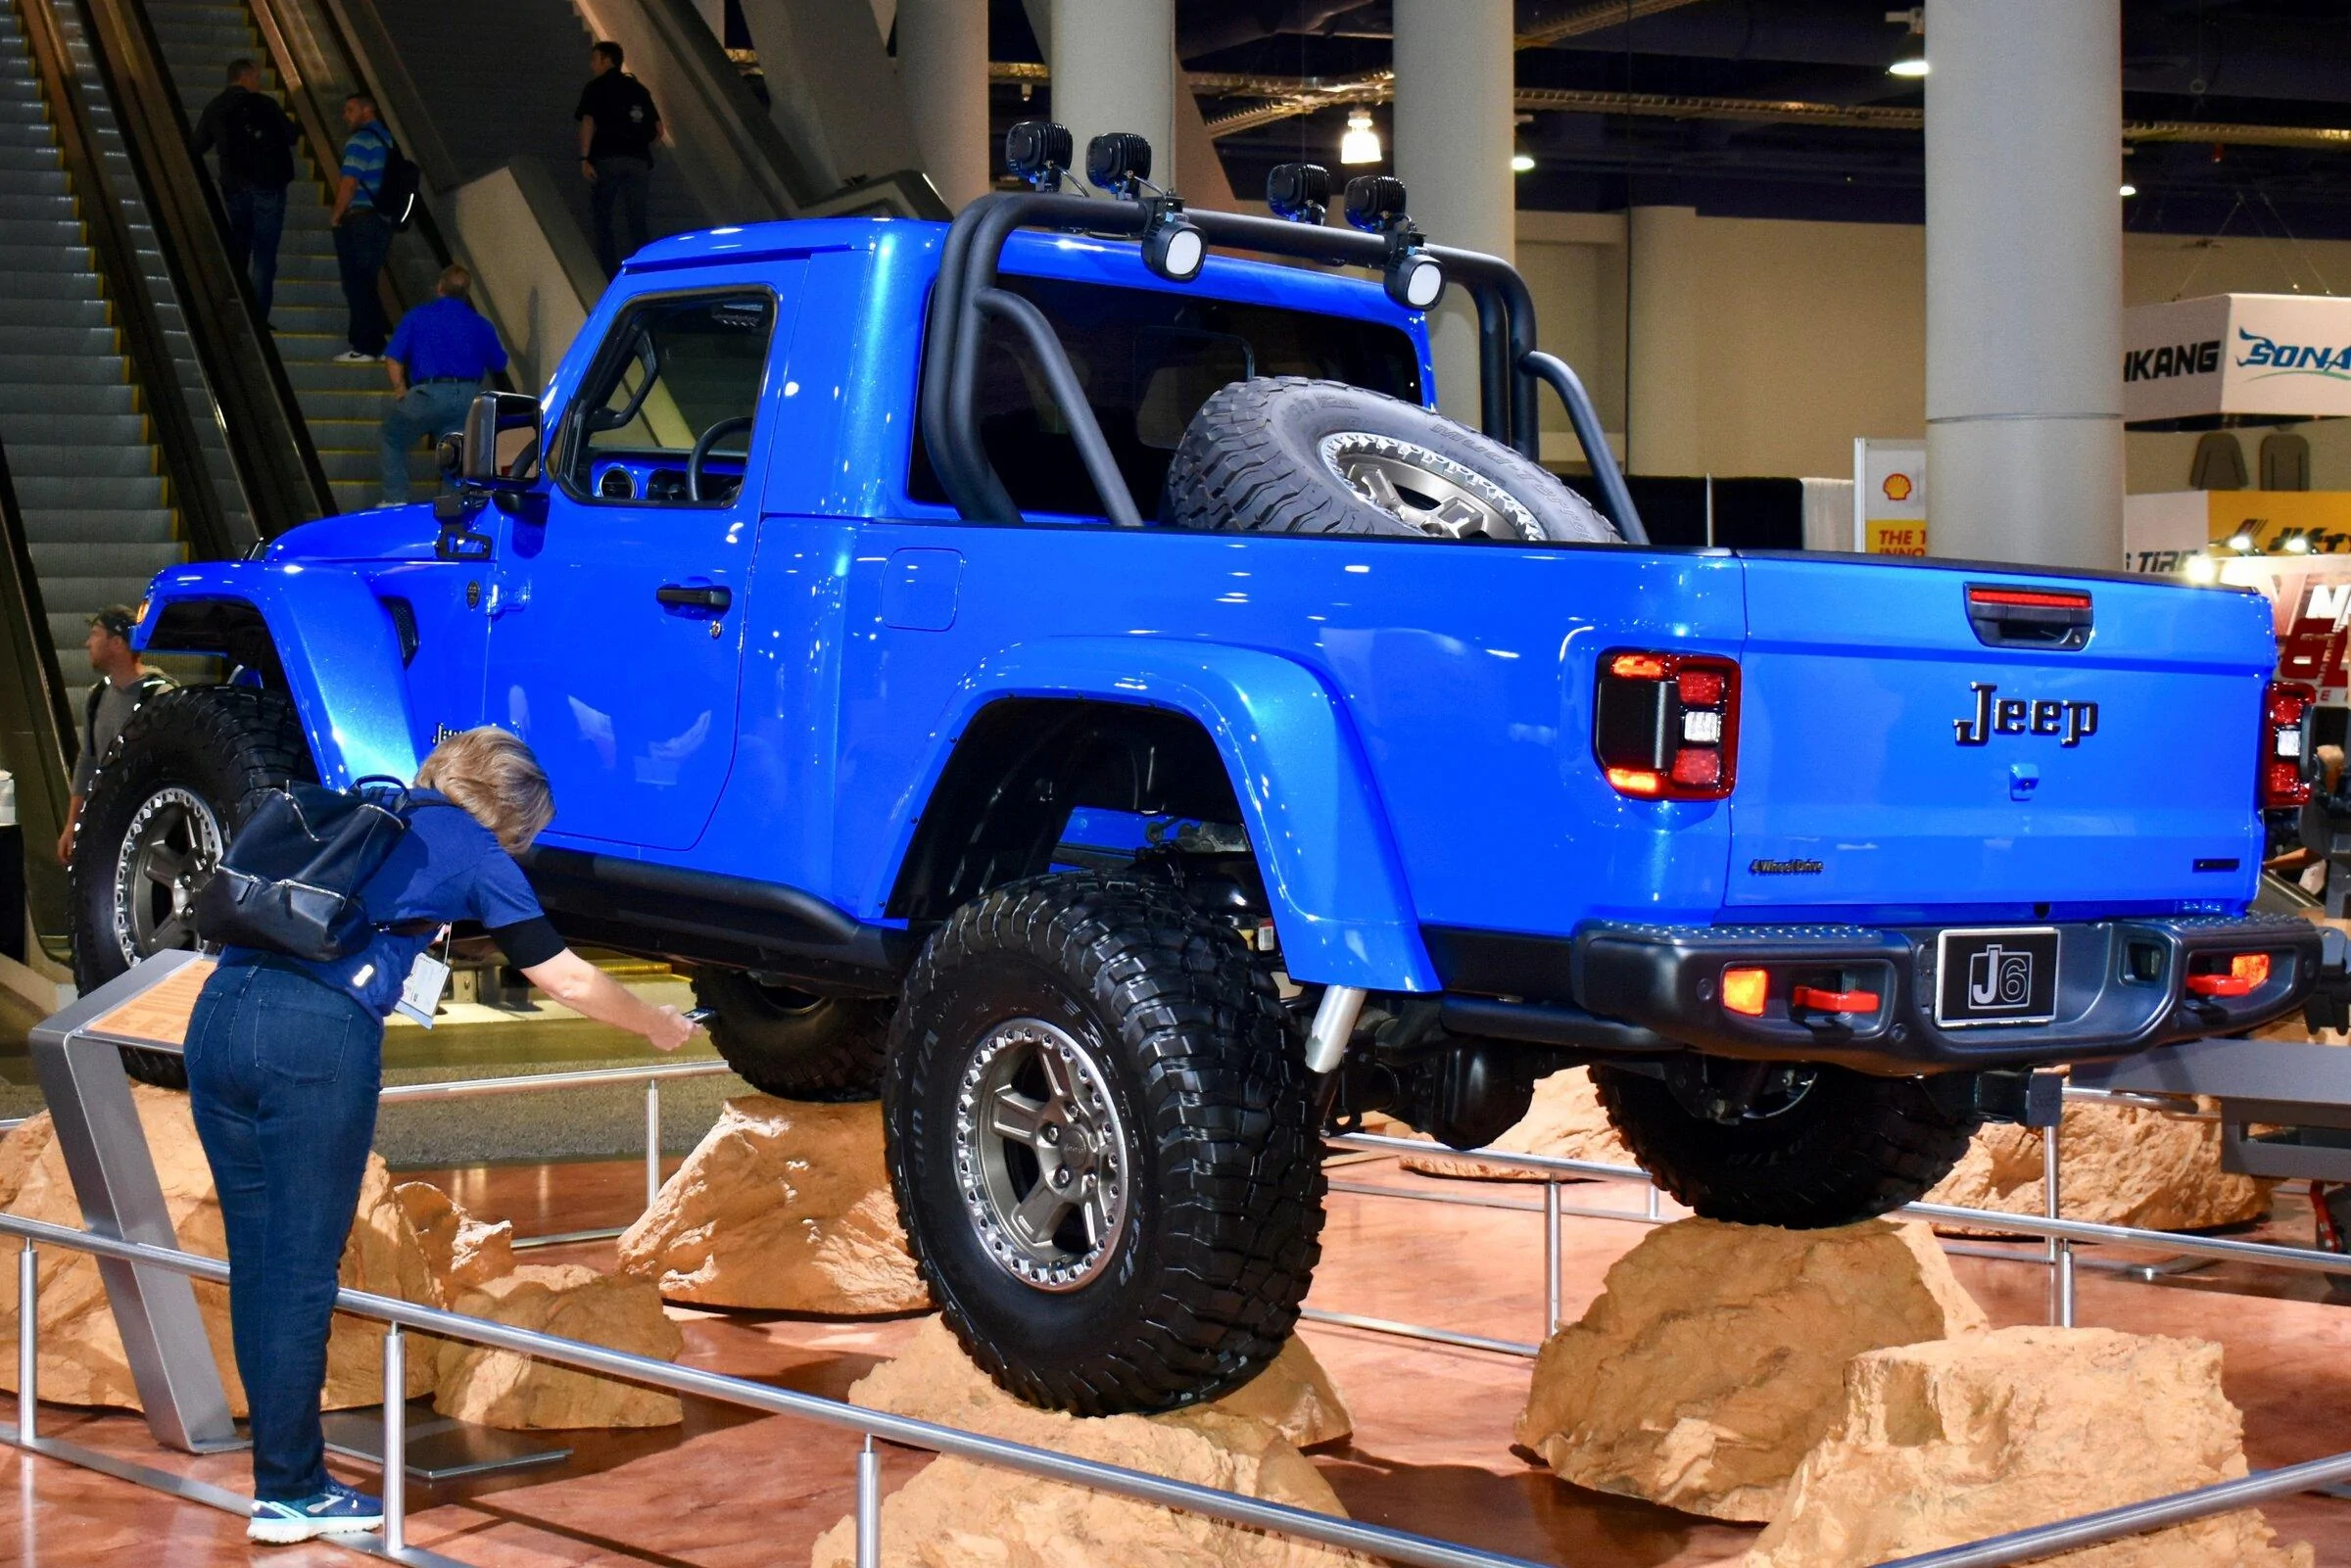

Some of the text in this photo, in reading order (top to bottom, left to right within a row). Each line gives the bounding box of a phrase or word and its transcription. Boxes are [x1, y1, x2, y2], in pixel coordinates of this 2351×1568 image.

[1879, 530, 1913, 546] THE
[1953, 682, 2098, 747] Jeep
[1972, 948, 2030, 1005] J6
